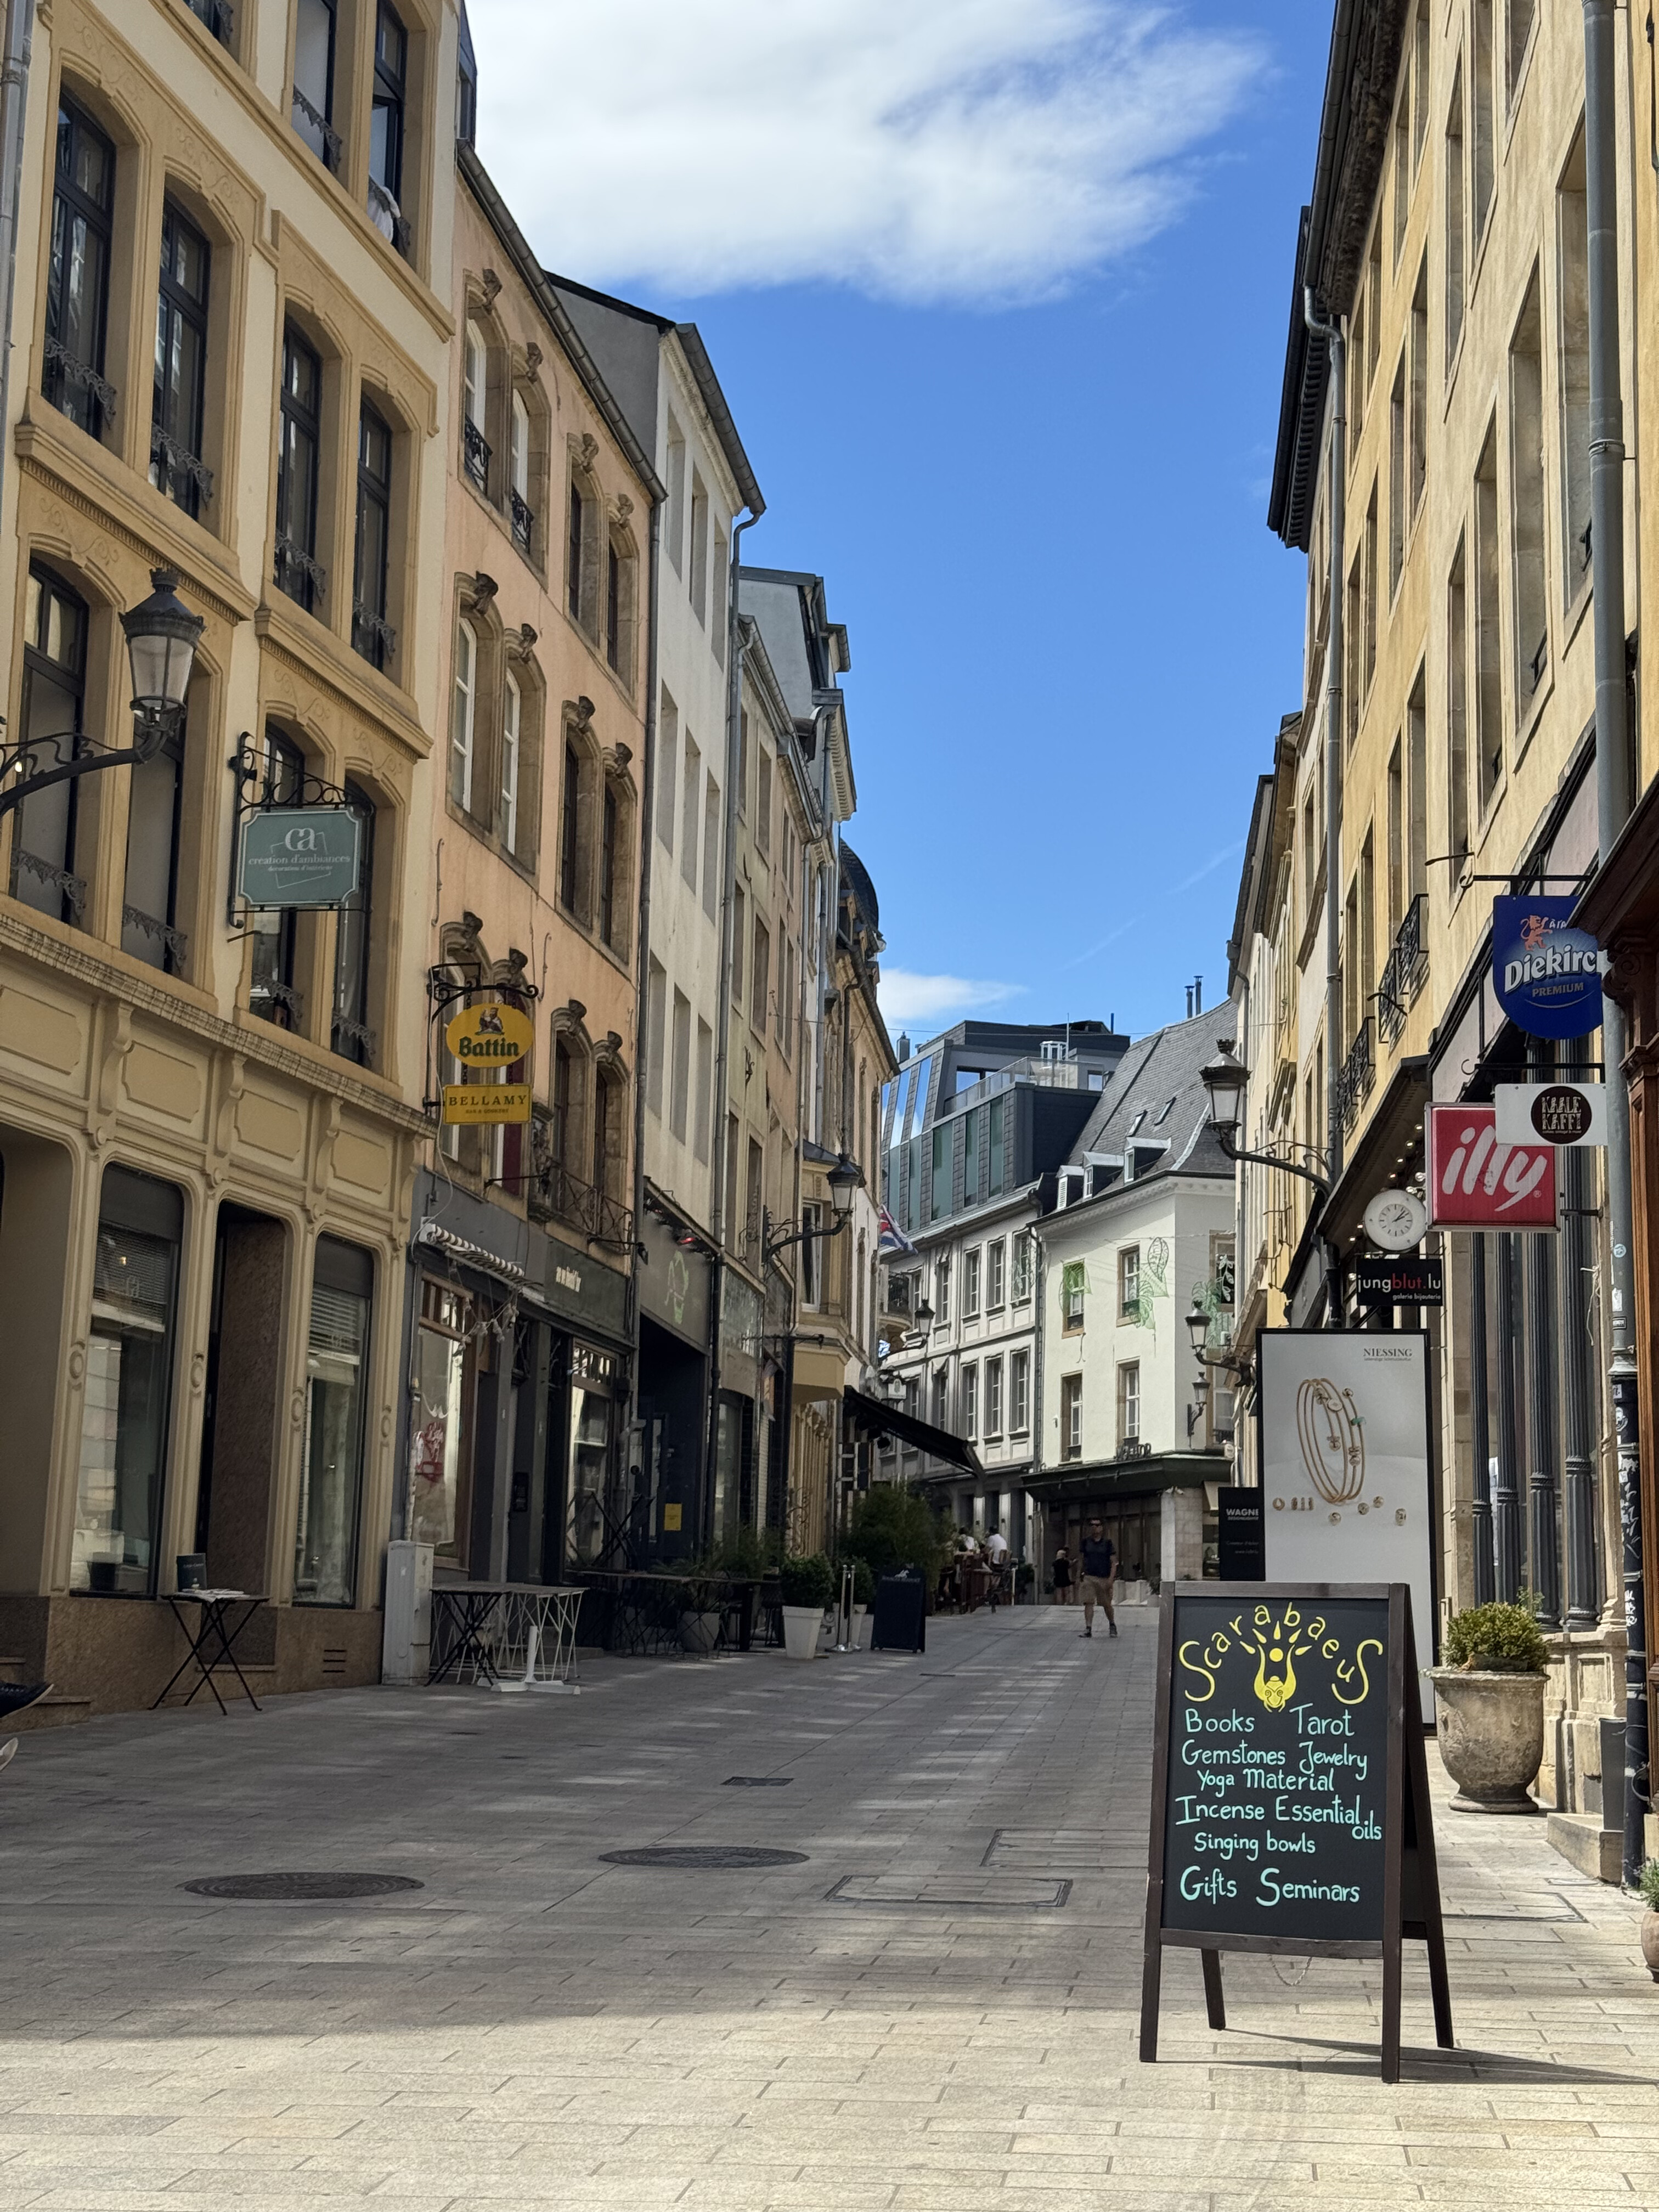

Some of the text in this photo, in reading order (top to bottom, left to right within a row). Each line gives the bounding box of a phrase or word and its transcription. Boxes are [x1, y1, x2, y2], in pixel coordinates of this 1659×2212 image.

[291, 854, 351, 864] d'ambiances
[1532, 982, 1584, 997] PREMIUM
[458, 1036, 520, 1057] Battin
[449, 1094, 527, 1107] BELLAMY
[1542, 1096, 1582, 1113] KAALE
[1442, 1125, 1548, 1212] illy
[1358, 1272, 1441, 1293] jungblut.lu
[1363, 1348, 1412, 1357] NIESSING
[1185, 1703, 1355, 1736] Books Tarot
[1182, 1739, 1368, 1781] Gemstones Jewelry
[1197, 1767, 1335, 1798] Yoga Material
[1175, 1794, 1383, 1841] Incense Essential oils
[1194, 1829, 1316, 1861] Singing bowls
[1180, 1865, 1361, 1907] Gifts Seminars
